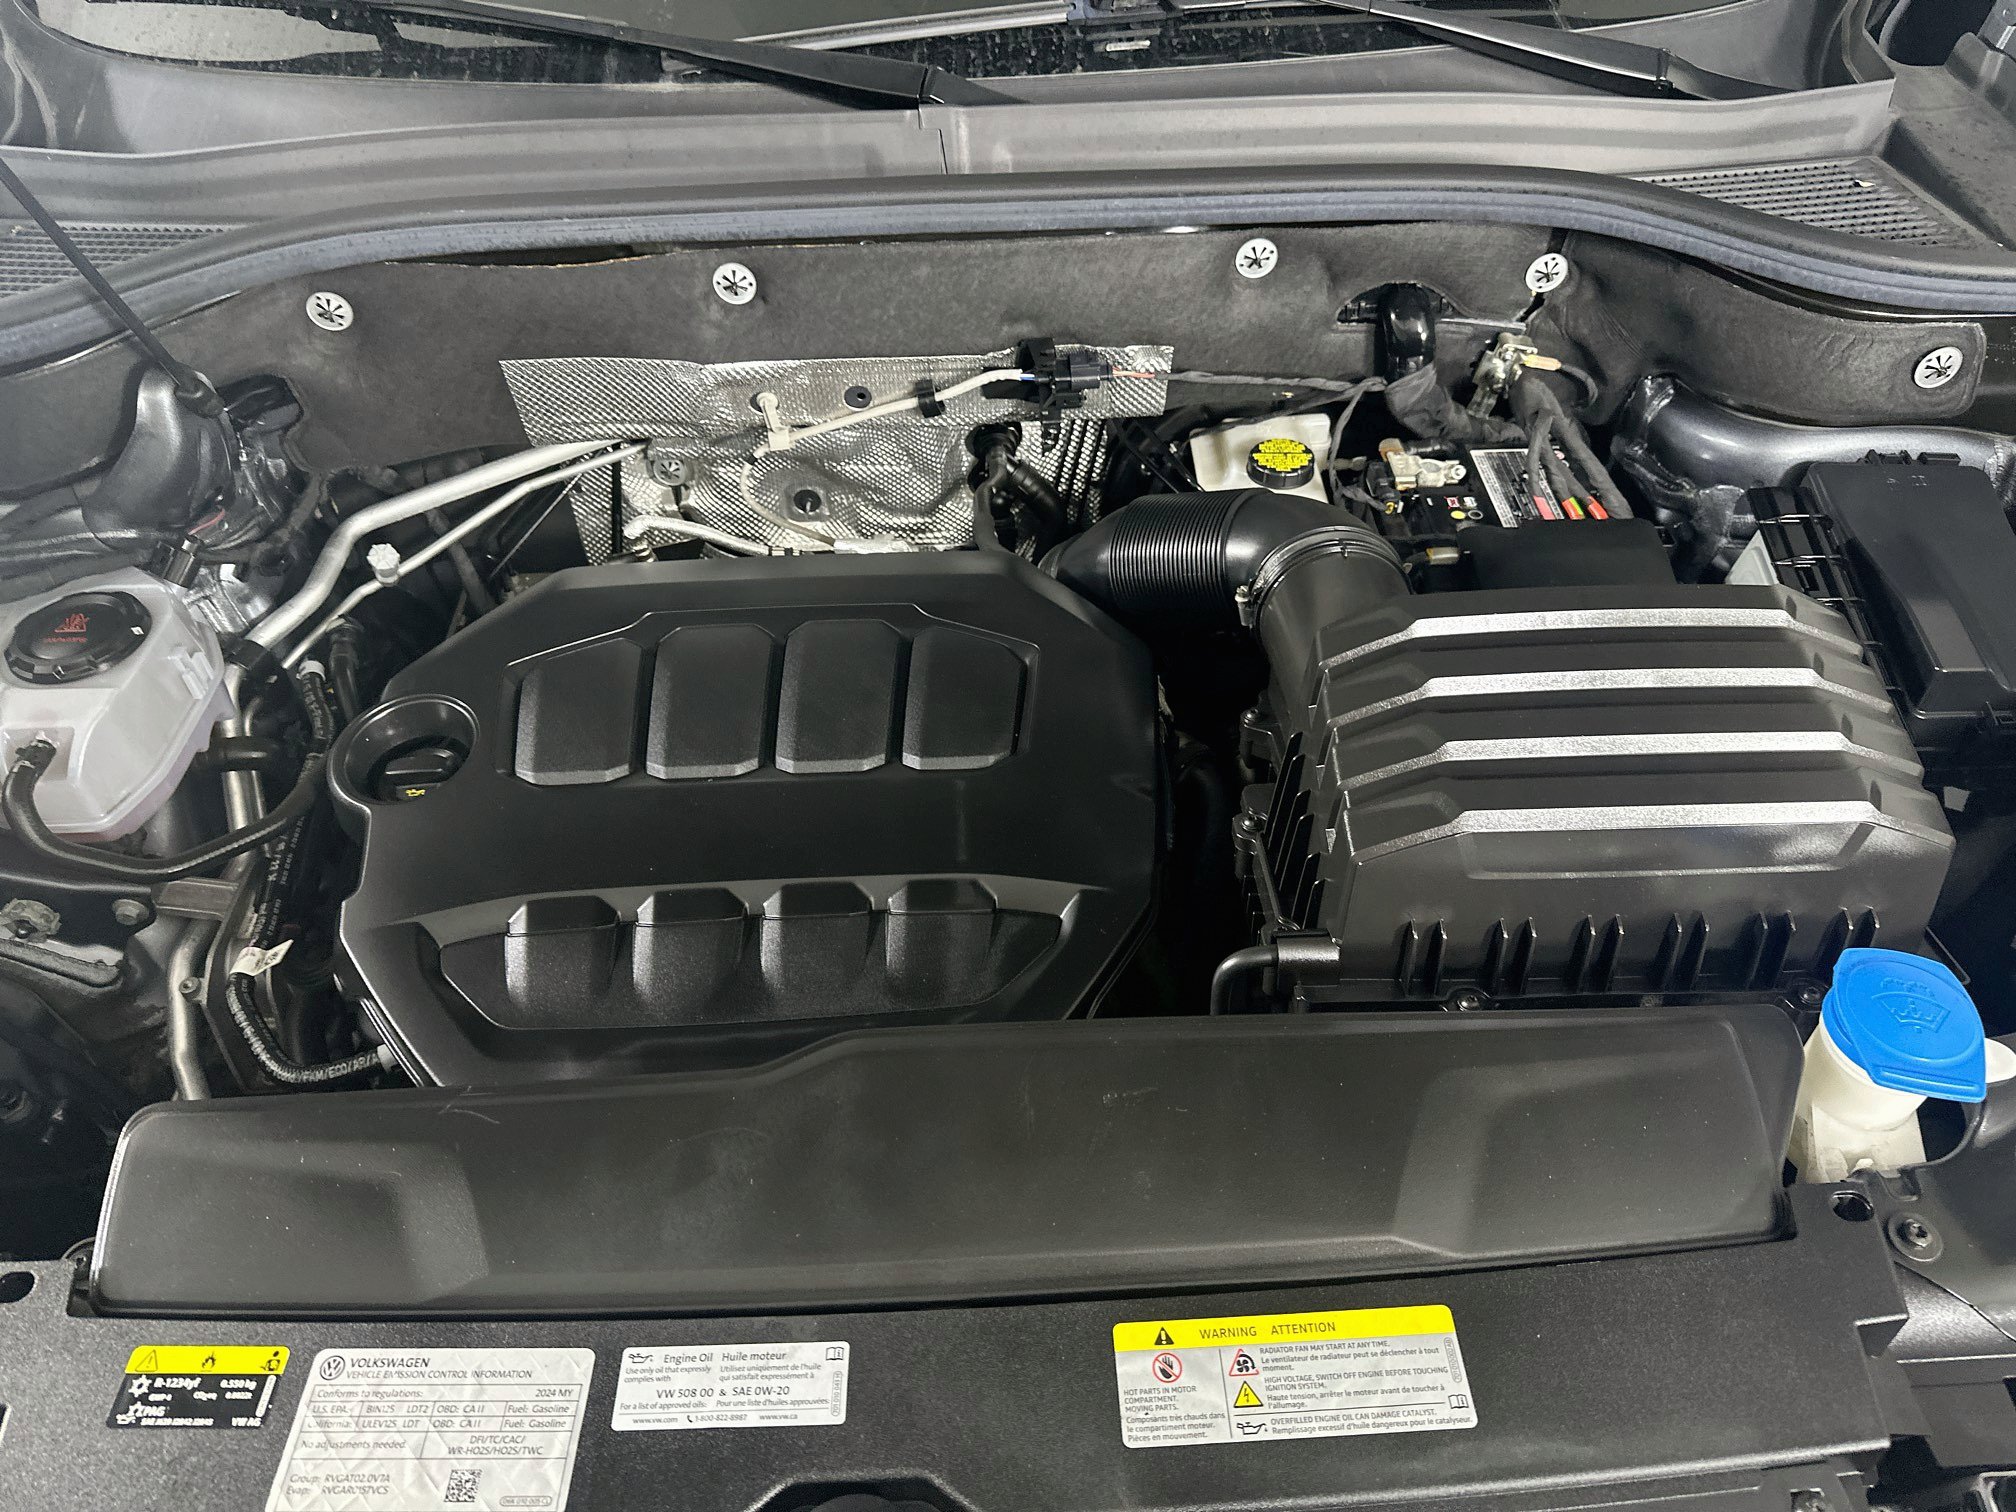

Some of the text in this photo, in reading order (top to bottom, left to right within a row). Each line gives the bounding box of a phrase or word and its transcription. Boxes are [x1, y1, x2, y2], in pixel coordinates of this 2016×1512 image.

[1200, 1322, 1336, 1339] WARNING ATTENTION
[1260, 1346, 1294, 1354] RADIATOR
[663, 1353, 713, 1365] Engine Oil
[722, 1352, 786, 1361] Huile moteur
[1271, 1355, 1308, 1363] ventilateur
[1353, 1352, 1369, 1360] peut
[1380, 1349, 1417, 1357] déclencher
[350, 1357, 430, 1368] VOLKSWAGEN
[720, 1362, 821, 1373] Utilisez uniquement de l'huile
[346, 1370, 532, 1379] VEHICLE EMISSION CONTROL INFORMATION
[625, 1367, 639, 1375] Use
[640, 1367, 654, 1376] only
[665, 1365, 679, 1373] that
[680, 1365, 711, 1374] expressly
[1281, 1375, 1315, 1383] VOLTAGE,
[1358, 1370, 1384, 1378] ENGINE
[1413, 1366, 1448, 1375] TOUCHING
[624, 1376, 654, 1384] complies
[719, 1374, 730, 1382] qui
[731, 1372, 759, 1381] satisfait
[1298, 1382, 1327, 1390] SYSTEM.
[317, 1389, 424, 1399] Conforms to regulations:
[535, 1389, 574, 1397] 2024 MY
[656, 1389, 676, 1398] VW
[677, 1388, 697, 1398] 508
[699, 1388, 714, 1397] 00
[732, 1386, 752, 1396] SAE
[754, 1386, 790, 1395] 0W-20
[1290, 1392, 1318, 1400] tension,
[1319, 1390, 1343, 1398] arrêter
[1412, 1384, 1438, 1392] toucher
[716, 1399, 732, 1407] Pour
[762, 1397, 788, 1406] d'huiles
[1125, 1396, 1179, 1404] COMPARTMENT.
[406, 1405, 430, 1413] LDT2
[436, 1405, 460, 1413] OBD:
[463, 1405, 476, 1413] CA
[507, 1404, 570, 1413] Fuel: Gasoline
[620, 1402, 631, 1410] For
[650, 1402, 658, 1410] of
[658, 1402, 691, 1411] approved
[1125, 1405, 1154, 1413] MOVING
[1268, 1401, 1307, 1410] l'allumage.
[1126, 1416, 1167, 1425] Composants
[1210, 1412, 1226, 1420] dans
[1271, 1417, 1313, 1425] OVERFILLED
[1314, 1415, 1341, 1423] ENGINE
[1343, 1413, 1354, 1421] OIL
[1372, 1410, 1400, 1419] DAMAGE
[1401, 1408, 1437, 1417] CATALYST.
[308, 1420, 353, 1429] Clifornia:
[432, 1420, 455, 1428] OBD:
[459, 1420, 472, 1428] CA
[504, 1419, 566, 1428] Fuel: Gasoline
[1136, 1424, 1186, 1433] compartiment
[1187, 1422, 1216, 1430] moteur.
[1272, 1426, 1316, 1435] Remplissage
[1317, 1424, 1344, 1432] excessif
[1346, 1422, 1370, 1430] d'huile
[1372, 1420, 1408, 1429] dangereux
[1410, 1419, 1426, 1428] pour
[1435, 1416, 1473, 1426] catalyseur.
[1128, 1434, 1150, 1442] Pièces
[1162, 1431, 1208, 1440] mouvement.
[302, 1441, 314, 1449] No
[315, 1440, 371, 1450] adjustments
[448, 1446, 543, 1455] WR-HO2S/HO2S/TWC
